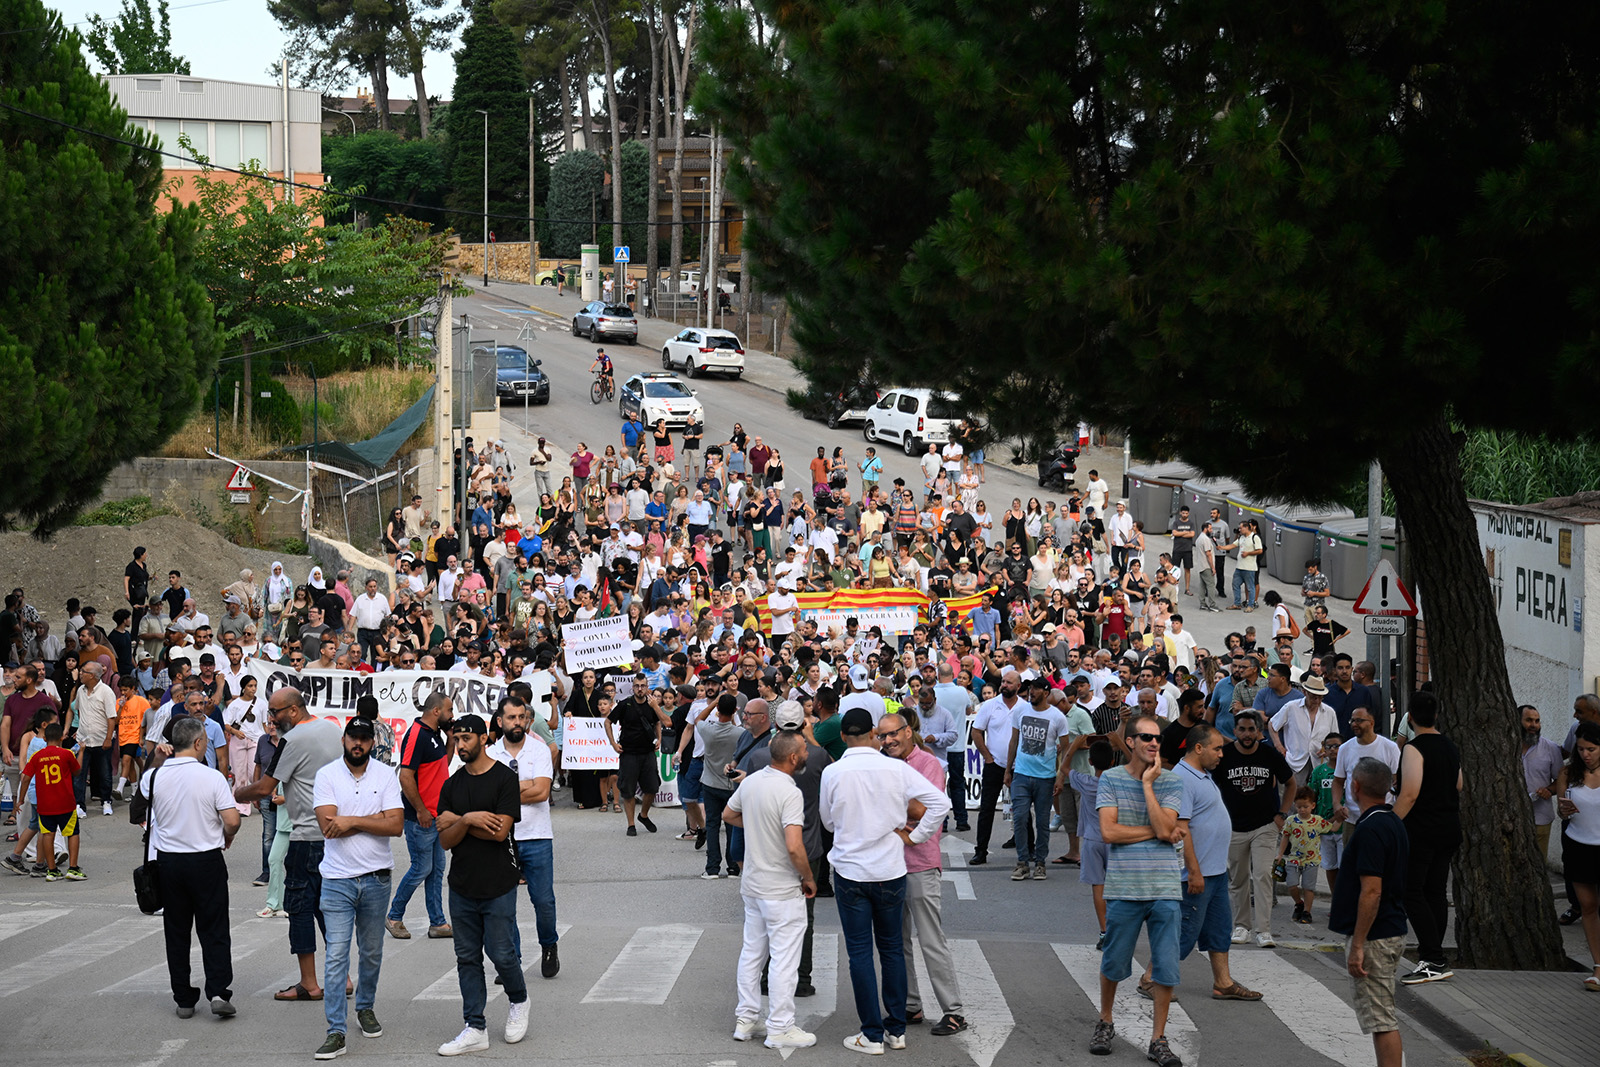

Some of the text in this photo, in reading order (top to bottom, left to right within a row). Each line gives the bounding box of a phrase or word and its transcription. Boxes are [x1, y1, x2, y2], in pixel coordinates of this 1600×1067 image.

[1487, 513, 1553, 545] MUNICIPAL
[1516, 566, 1568, 627] PIERA
[569, 617, 622, 632] SOLIDARIDAD
[1372, 617, 1398, 625] Riuades
[1370, 626, 1400, 634] sobtades
[575, 643, 622, 657] COMUNIDAD
[576, 655, 624, 669] MUSULMANA
[379, 681, 408, 705] els
[568, 737, 607, 746] AGRESIÓN
[41, 763, 62, 785] 19
[1227, 767, 1270, 779] JACK & JONES
[1241, 776, 1256, 787] 90
[655, 791, 673, 802] ntra
